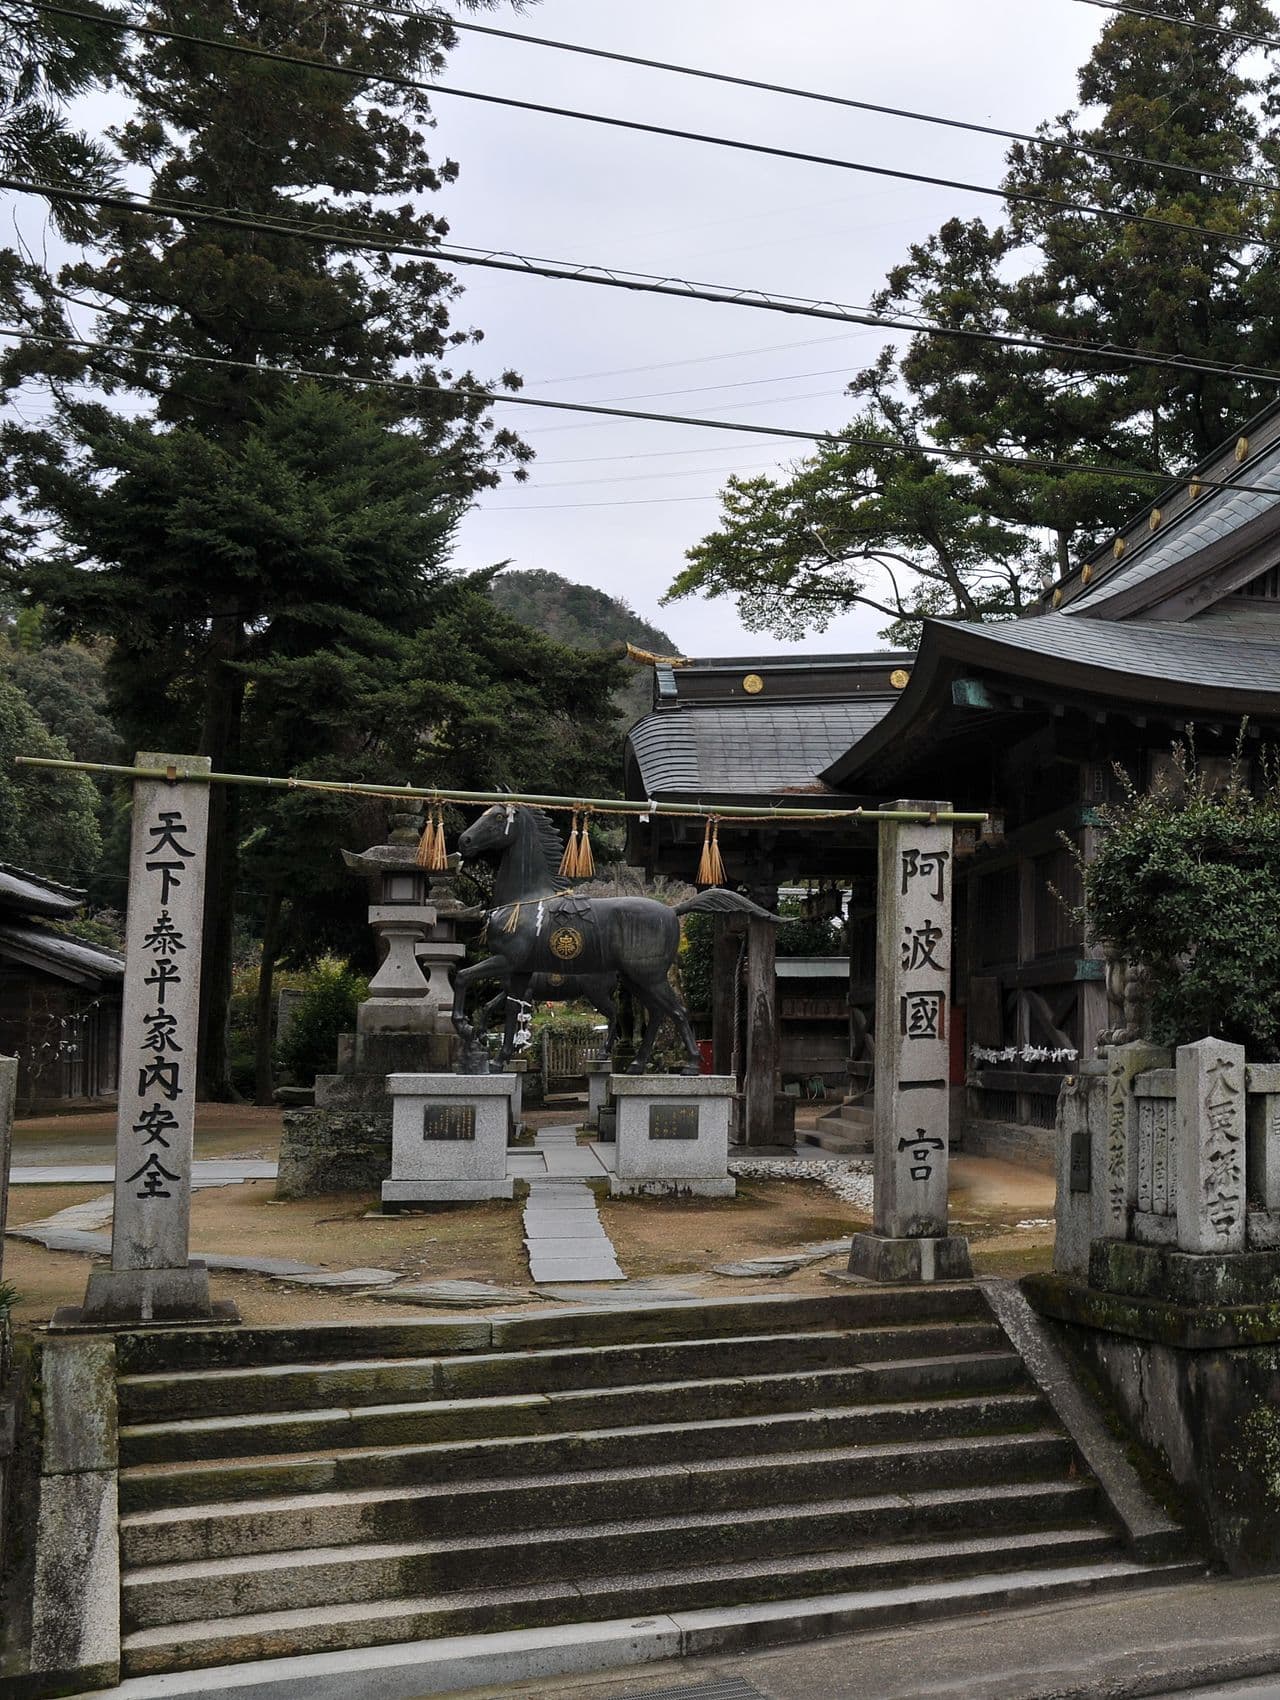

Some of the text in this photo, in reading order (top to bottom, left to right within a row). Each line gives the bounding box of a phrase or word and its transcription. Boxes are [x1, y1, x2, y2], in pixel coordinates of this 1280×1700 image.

[124, 810, 196, 1200] 天下泰平家内安全
[897, 848, 949, 1183] 阿波國一宮
